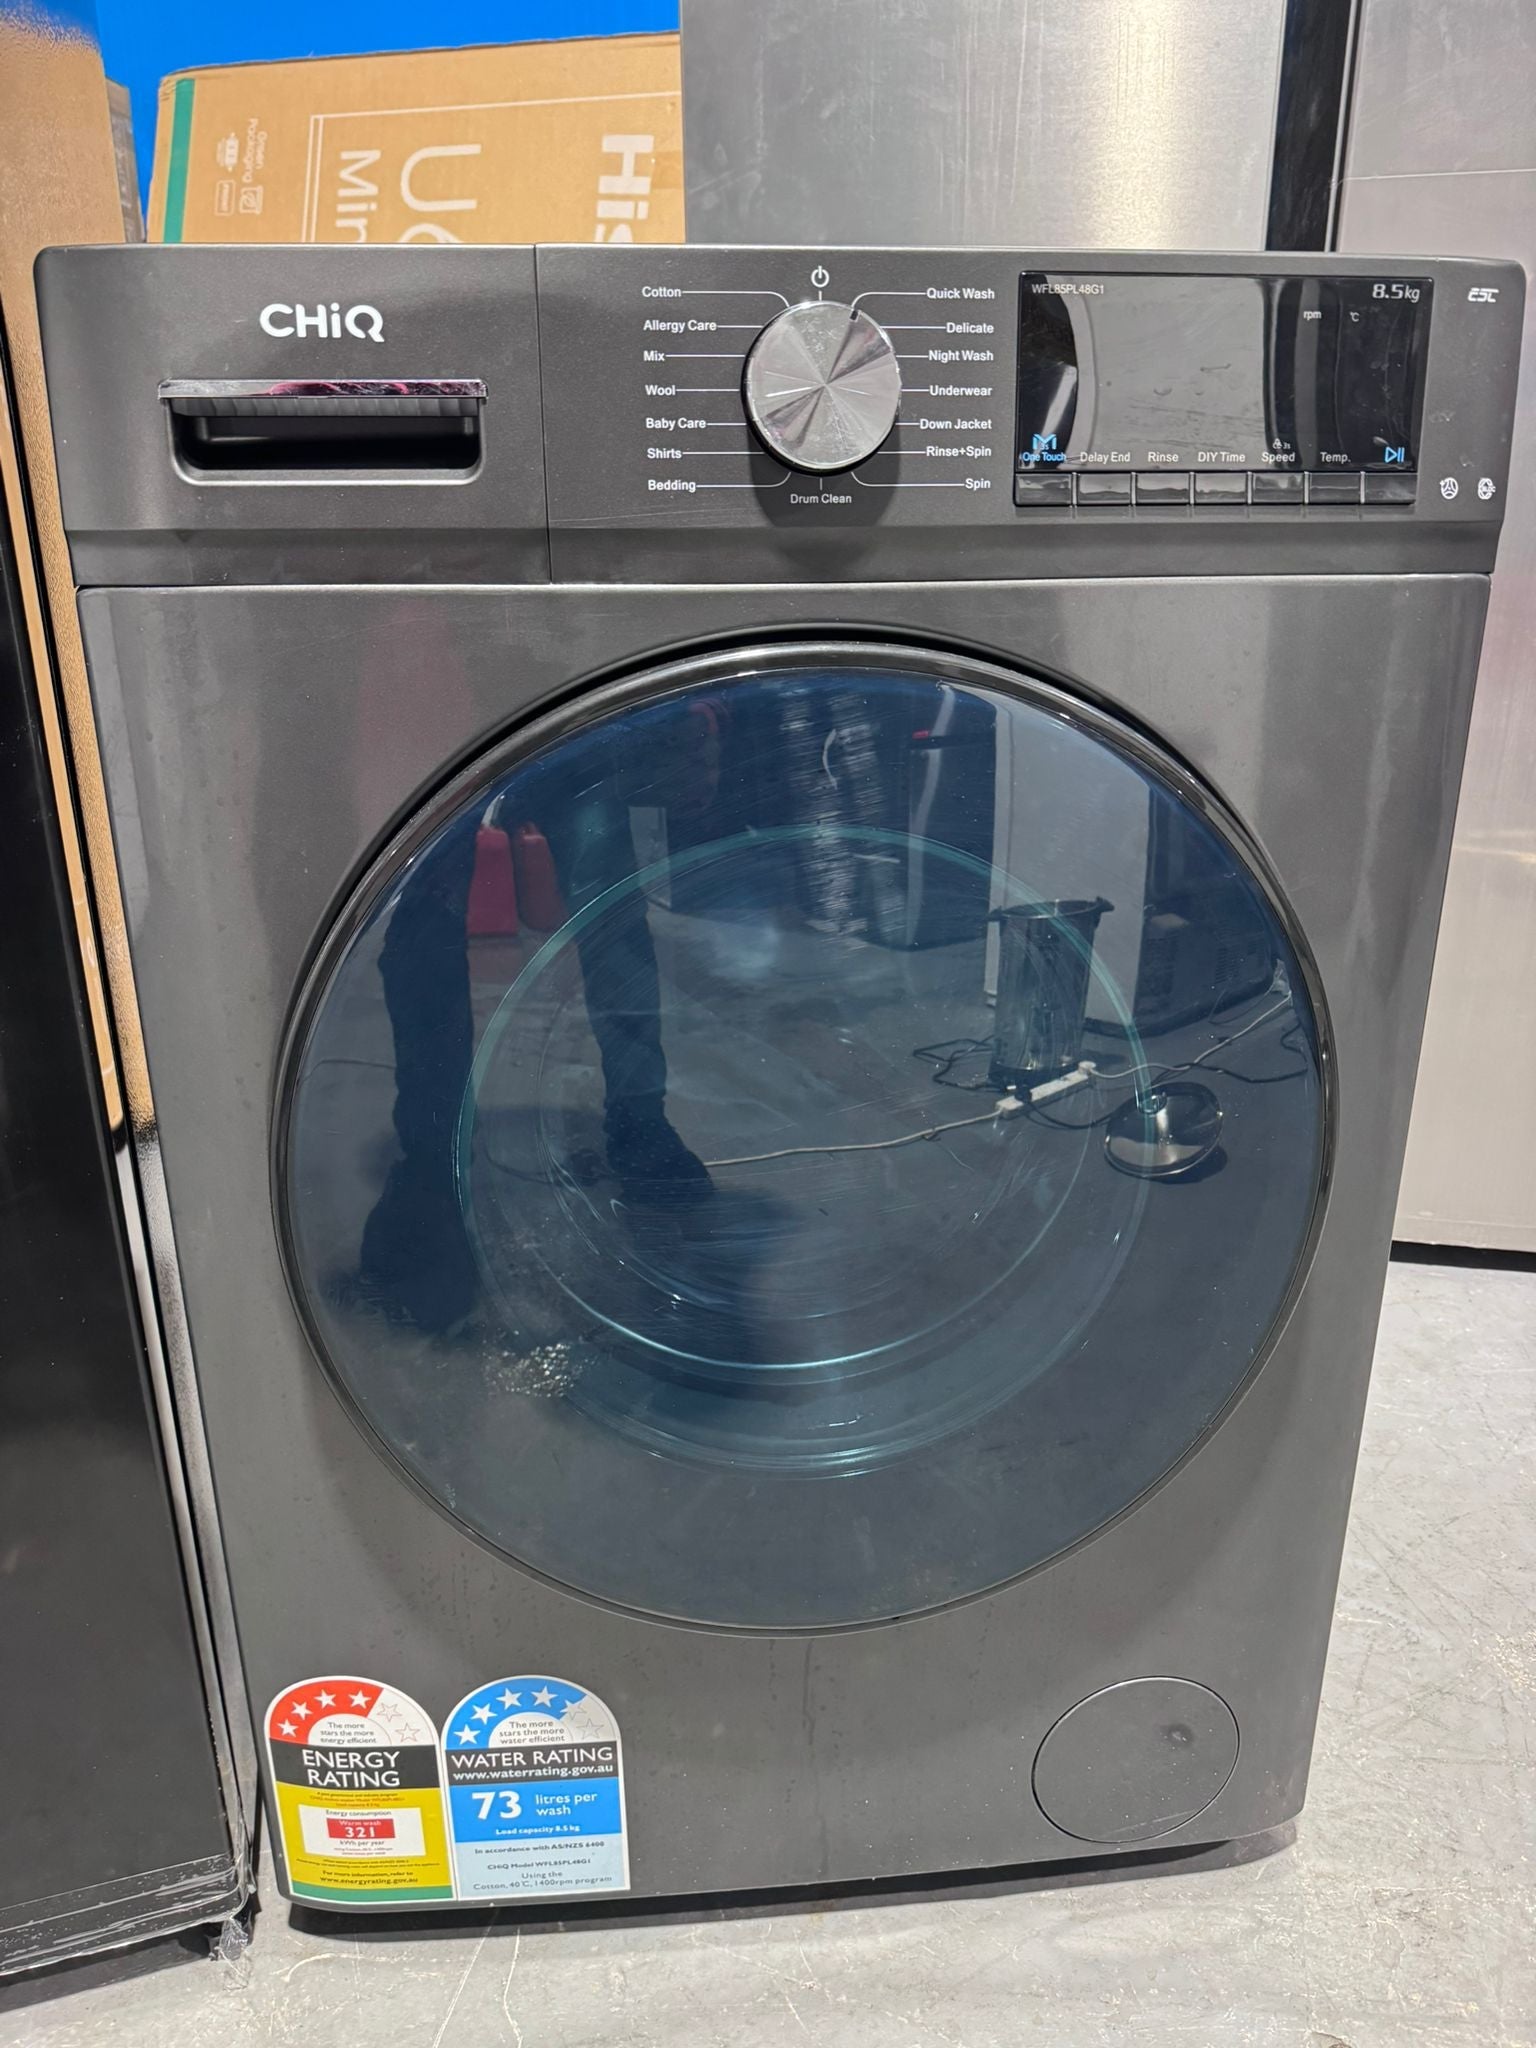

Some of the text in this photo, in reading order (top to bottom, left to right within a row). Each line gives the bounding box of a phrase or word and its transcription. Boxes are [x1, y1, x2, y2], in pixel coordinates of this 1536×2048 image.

[642, 287, 681, 297] Cotton
[1032, 284, 1104, 294] WFL85PL48G1
[927, 289, 995, 301] Quick Wash
[1303, 311, 1322, 320] rpm
[260, 303, 385, 342] CHiQ
[643, 320, 717, 333] Allergy Care
[946, 323, 994, 333] Delicate
[644, 351, 665, 361] Mix
[928, 351, 994, 363] Night Wash
[645, 385, 676, 396] Wool
[930, 385, 992, 396] Underwear
[646, 418, 706, 431] Baby Care
[920, 419, 992, 430] Down Jacket
[647, 448, 682, 459] Shirts
[926, 446, 991, 459] Rinse+Spin
[1023, 451, 1066, 462] One Touch
[1080, 452, 1130, 464] Delay End
[1148, 452, 1179, 462] Rinse
[1198, 452, 1246, 462] DIY Time
[1261, 452, 1296, 464] Speed
[1320, 452, 1351, 464] Temp.
[648, 480, 696, 492] Bedding
[965, 479, 991, 491] Spin
[790, 494, 852, 504] Drum Clean
[529, 1736, 565, 1744] efficient
[302, 1749, 400, 1769] ENERGY
[451, 1747, 613, 1769] WATER RATING
[308, 1768, 400, 1787] RATING
[453, 1763, 614, 1781] www.waterrating.gov.au
[536, 1793, 598, 1805] litres per
[471, 1790, 522, 1820] 73
[536, 1805, 571, 1816] wash
[345, 1827, 375, 1838] 321
[519, 1826, 554, 1835] capacity
[570, 1824, 580, 1832] kg
[485, 1846, 530, 1854] accordance
[551, 1842, 583, 1850] AS/NZS
[320, 1877, 418, 1885] www.energyrating.gov.au
[522, 1872, 546, 1880] Using
[473, 1882, 508, 1890] Cotton,
[575, 1876, 612, 1885] program
